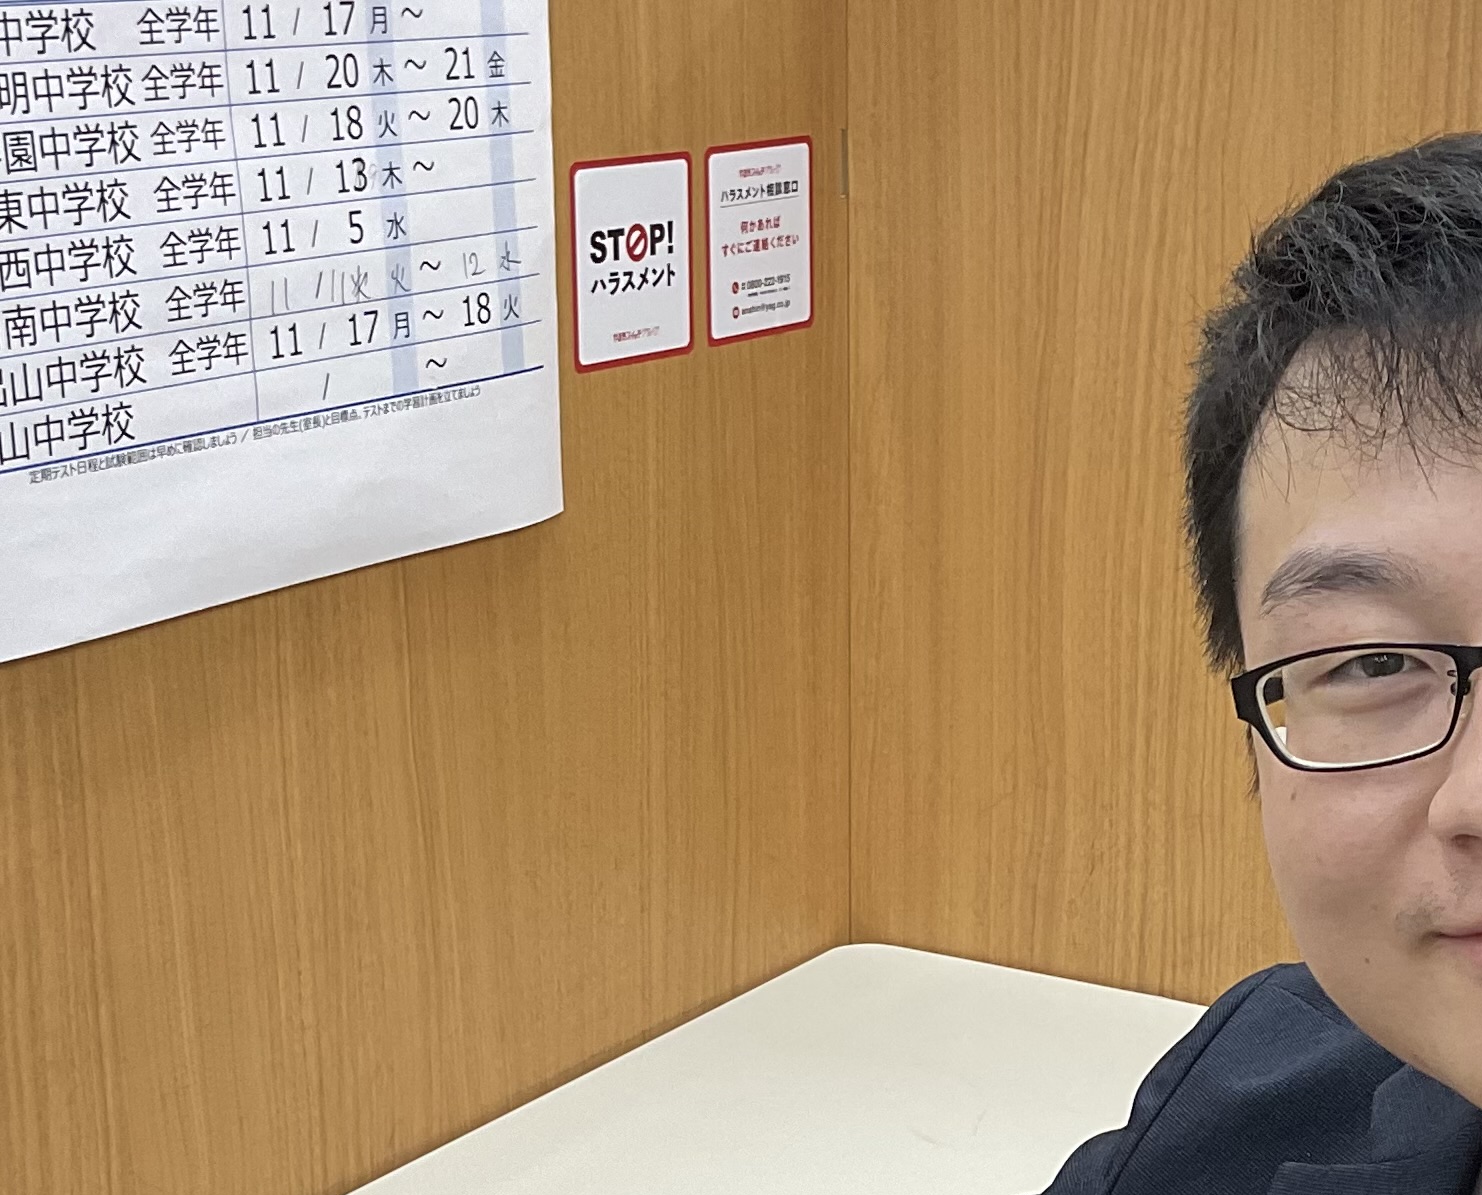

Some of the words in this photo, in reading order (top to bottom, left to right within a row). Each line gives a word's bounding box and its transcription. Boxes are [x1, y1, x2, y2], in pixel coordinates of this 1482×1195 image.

[137, 5, 220, 45] 全学年
[243, 4, 276, 40] 11
[323, 1, 354, 36] 17
[371, 7, 387, 34] 月
[0, 63, 135, 115] 明中学校
[141, 61, 224, 102] 全学年
[246, 58, 280, 95] 11
[325, 53, 359, 89] 20
[373, 58, 394, 86] 木
[445, 47, 475, 80] 21
[487, 50, 505, 78] 金
[150, 118, 226, 156] 全学年
[251, 112, 286, 149] 11
[331, 105, 363, 141] 18
[378, 110, 398, 138] 火
[448, 96, 479, 130] 20
[491, 101, 509, 128] 木
[0, 178, 131, 234] 東中学校
[153, 171, 236, 213] 全学年
[257, 166, 291, 202] 11
[335, 157, 367, 194] 13
[382, 161, 402, 189] 木
[0, 234, 137, 292] 西中学校
[160, 225, 241, 268] 全学年
[262, 219, 296, 256] 11
[349, 210, 364, 244] 5
[387, 212, 406, 240] 水
[590, 220, 674, 264] STOP!
[591, 263, 675, 295] ハラスメント
[2, 289, 142, 350] 南中学校
[165, 278, 245, 322] 全学年
[0, 344, 147, 407] 山中学校
[168, 331, 249, 376] 全学年
[270, 322, 303, 359] 11
[349, 310, 379, 346] 17
[393, 311, 410, 340] 月
[462, 292, 491, 327] 18
[503, 294, 520, 321] 火
[0, 401, 136, 466] 山中学校
